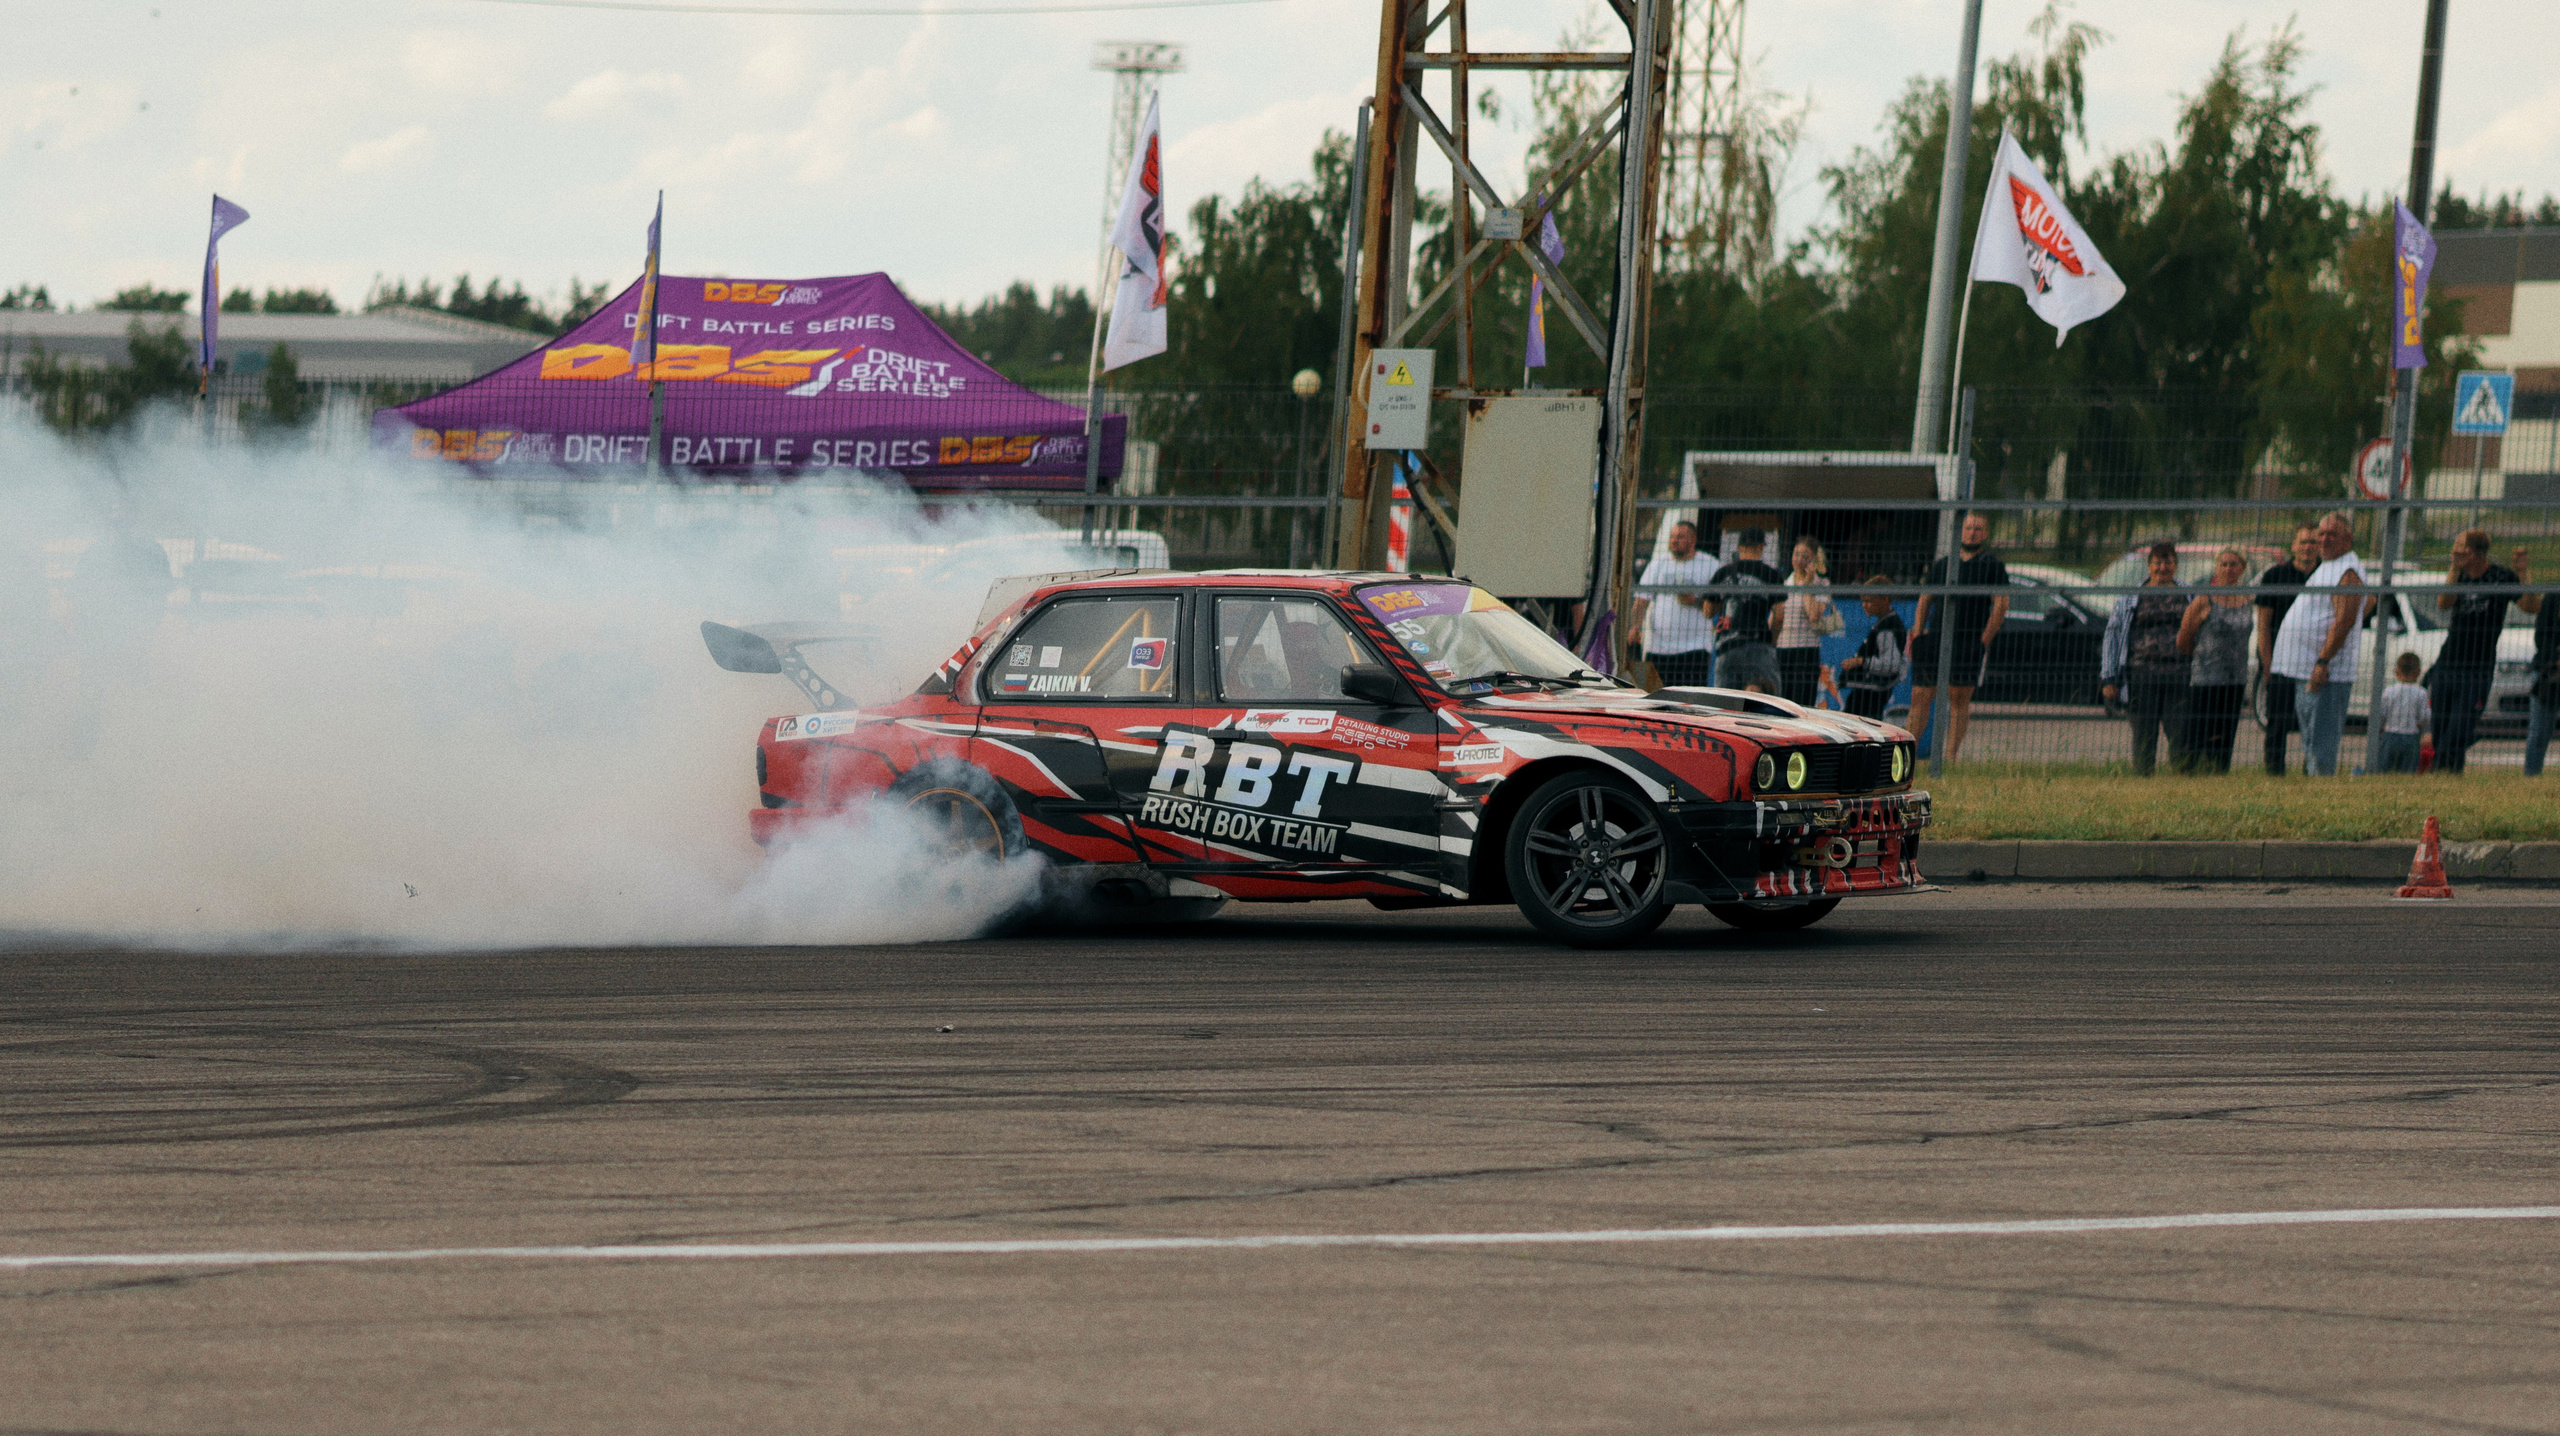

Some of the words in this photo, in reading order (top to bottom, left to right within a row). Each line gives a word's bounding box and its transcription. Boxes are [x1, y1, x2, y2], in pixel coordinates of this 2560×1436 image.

[703, 282, 787, 304] DBS
[624, 313, 692, 330] DIFT
[702, 317, 795, 335] BATTLE
[806, 313, 896, 334] SERIES
[540, 342, 841, 389] DBS
[867, 347, 951, 377] DRIFT
[836, 376, 951, 398] SERIES
[409, 428, 514, 462] DBS
[563, 434, 651, 465] DRIFT
[670, 436, 795, 466] BATTLE
[810, 438, 931, 467] SERIES
[938, 436, 1043, 465] DBS
[1367, 590, 1423, 613] DBS
[1385, 618, 1426, 640] 55
[1028, 675, 1079, 693] ZAIKIN
[1080, 675, 1093, 693] V.
[1331, 733, 1375, 750] AUTO
[1334, 725, 1408, 750] PERFECT
[1337, 718, 1379, 734] DETAILING
[1380, 727, 1411, 742] STUDIO
[1149, 729, 1354, 819] RBT
[1140, 796, 1212, 834] RUSH
[1212, 810, 1266, 844] BOX
[1270, 819, 1338, 854] TEAM
